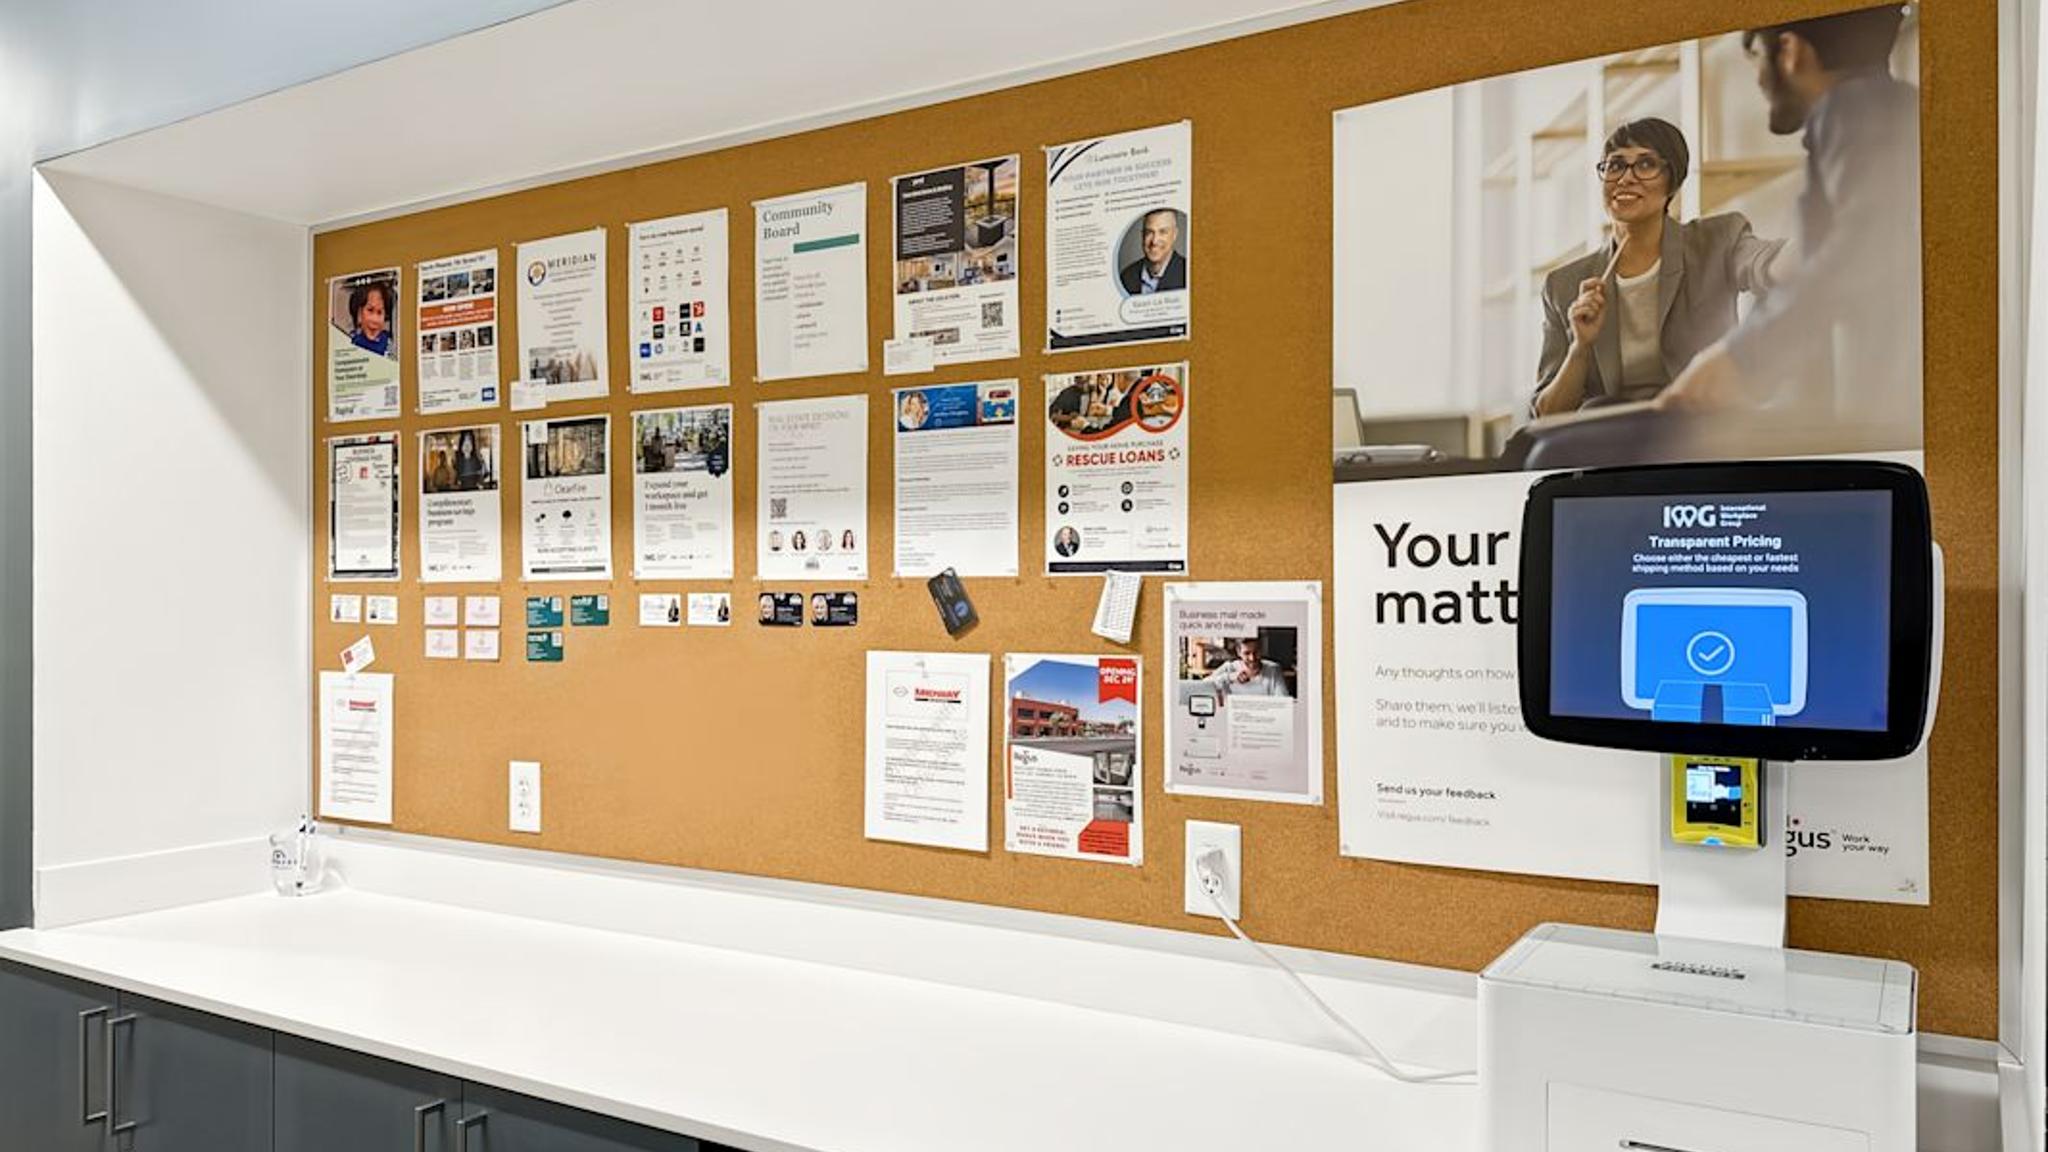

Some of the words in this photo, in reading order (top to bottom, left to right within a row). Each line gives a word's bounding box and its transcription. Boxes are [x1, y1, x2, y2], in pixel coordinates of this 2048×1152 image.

[763, 201, 833, 222] Community
[763, 222, 800, 239] Board
[547, 253, 596, 268] MERIDIAN
[1066, 452, 1116, 466] RESCUE
[1119, 449, 1165, 464] LOANS
[1663, 504, 1716, 528] IWG
[1373, 522, 1510, 568] Your
[1649, 535, 1730, 550] Transparent
[1732, 535, 1782, 550] Pricing
[1632, 553, 1666, 563] Choose
[1667, 553, 1693, 563] either
[1694, 553, 1709, 563] the
[1710, 553, 1753, 565] cheapest
[1754, 555, 1763, 563] or
[1765, 553, 1799, 563] fastest
[1632, 564, 1668, 574] shipping
[1670, 564, 1704, 573] method
[1706, 564, 1733, 573] based
[1735, 565, 1747, 573] on
[1749, 565, 1769, 574] your
[1770, 564, 1799, 573] needs
[1376, 579, 1519, 624] matt
[1179, 610, 1218, 619] Business
[1240, 610, 1266, 619] made
[1179, 621, 1203, 631] quick
[1205, 621, 1221, 630] and
[1223, 622, 1245, 631] easy
[1375, 664, 1399, 681] Any
[1401, 666, 1462, 681] thoughts
[1465, 668, 1483, 679] on
[1486, 667, 1514, 679] how
[1375, 698, 1413, 712] Share
[1456, 701, 1486, 714] we'll
[1488, 701, 1521, 715] liste
[1375, 716, 1400, 728] and
[1402, 717, 1416, 728] to
[1419, 718, 1455, 730] make
[1457, 720, 1488, 731] sure
[1490, 721, 1516, 734] you
[1377, 782, 1403, 794] Send
[1404, 787, 1417, 795] us
[1419, 787, 1442, 798] your
[1445, 786, 1496, 800] feedback
[1841, 833, 1870, 843] Work
[1842, 843, 1865, 852] your
[1868, 844, 1890, 854] way
